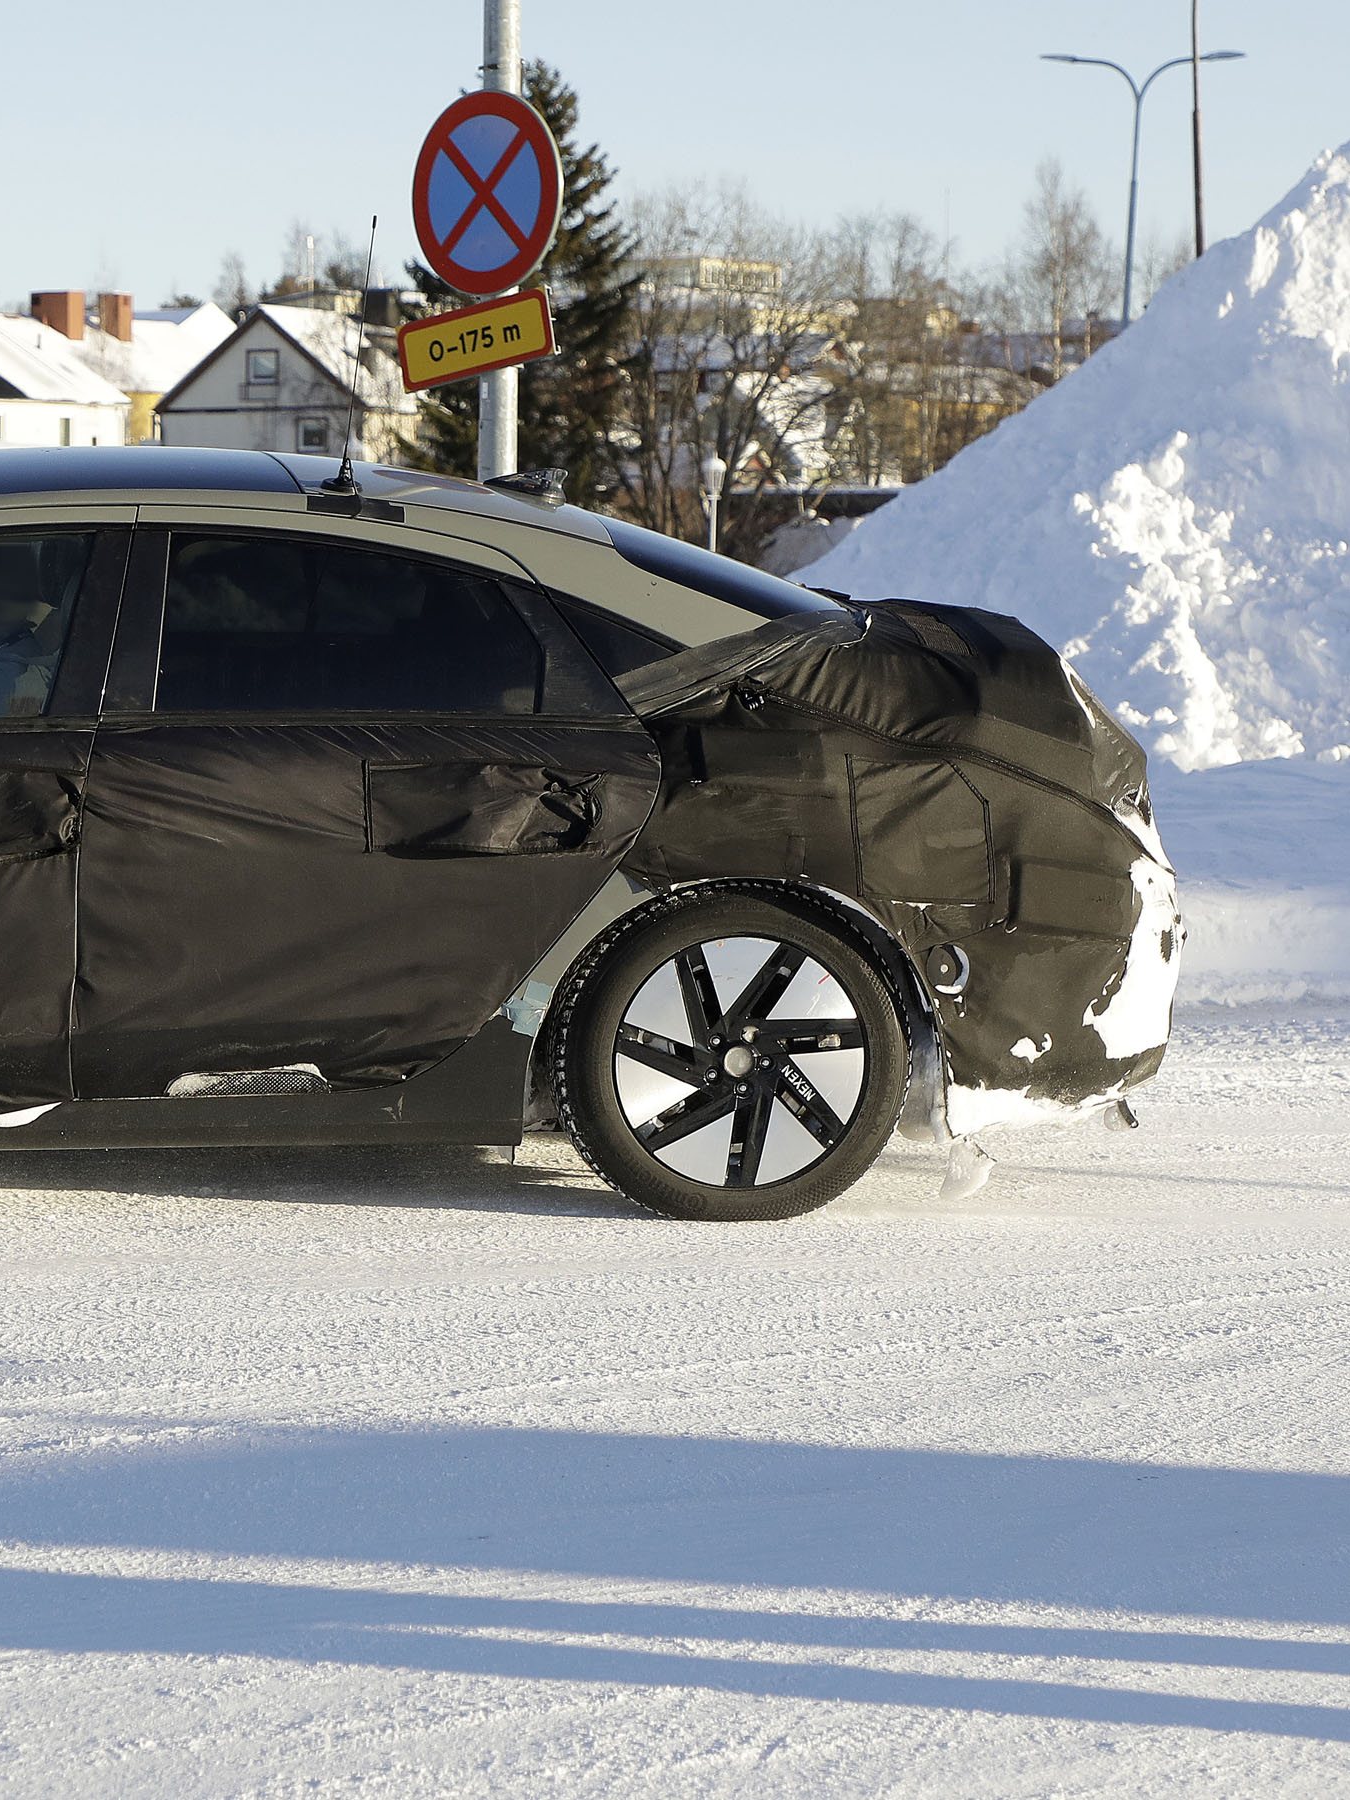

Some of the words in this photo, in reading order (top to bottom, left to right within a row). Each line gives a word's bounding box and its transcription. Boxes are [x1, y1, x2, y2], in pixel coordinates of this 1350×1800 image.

[429, 325, 494, 362] 0-175
[503, 323, 521, 343] m
[781, 1065, 816, 1101] NEXEN
